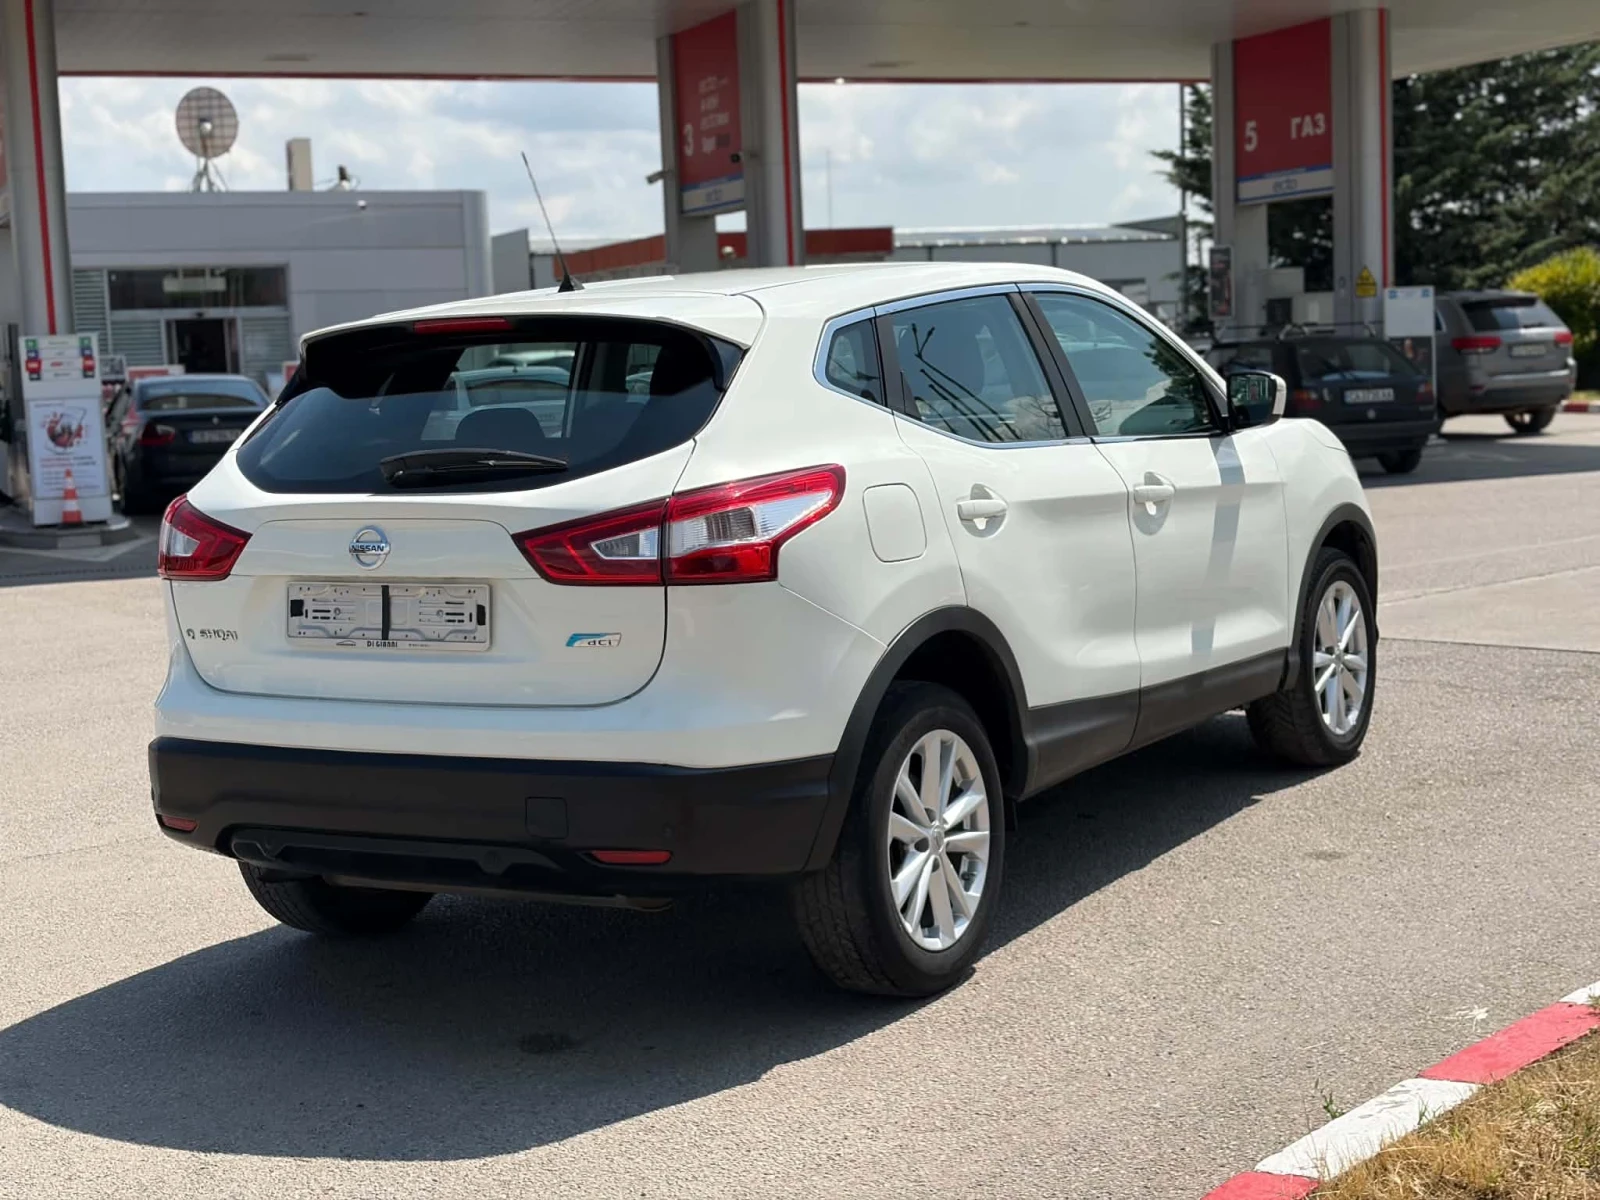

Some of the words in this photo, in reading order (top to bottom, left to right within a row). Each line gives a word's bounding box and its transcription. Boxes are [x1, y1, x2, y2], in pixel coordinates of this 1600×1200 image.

[684, 123, 693, 156] 3
[1244, 121, 1258, 151] 5
[1290, 113, 1326, 139] ГАЗ
[351, 544, 385, 552] NISSAN
[186, 628, 239, 641] QSHQAI
